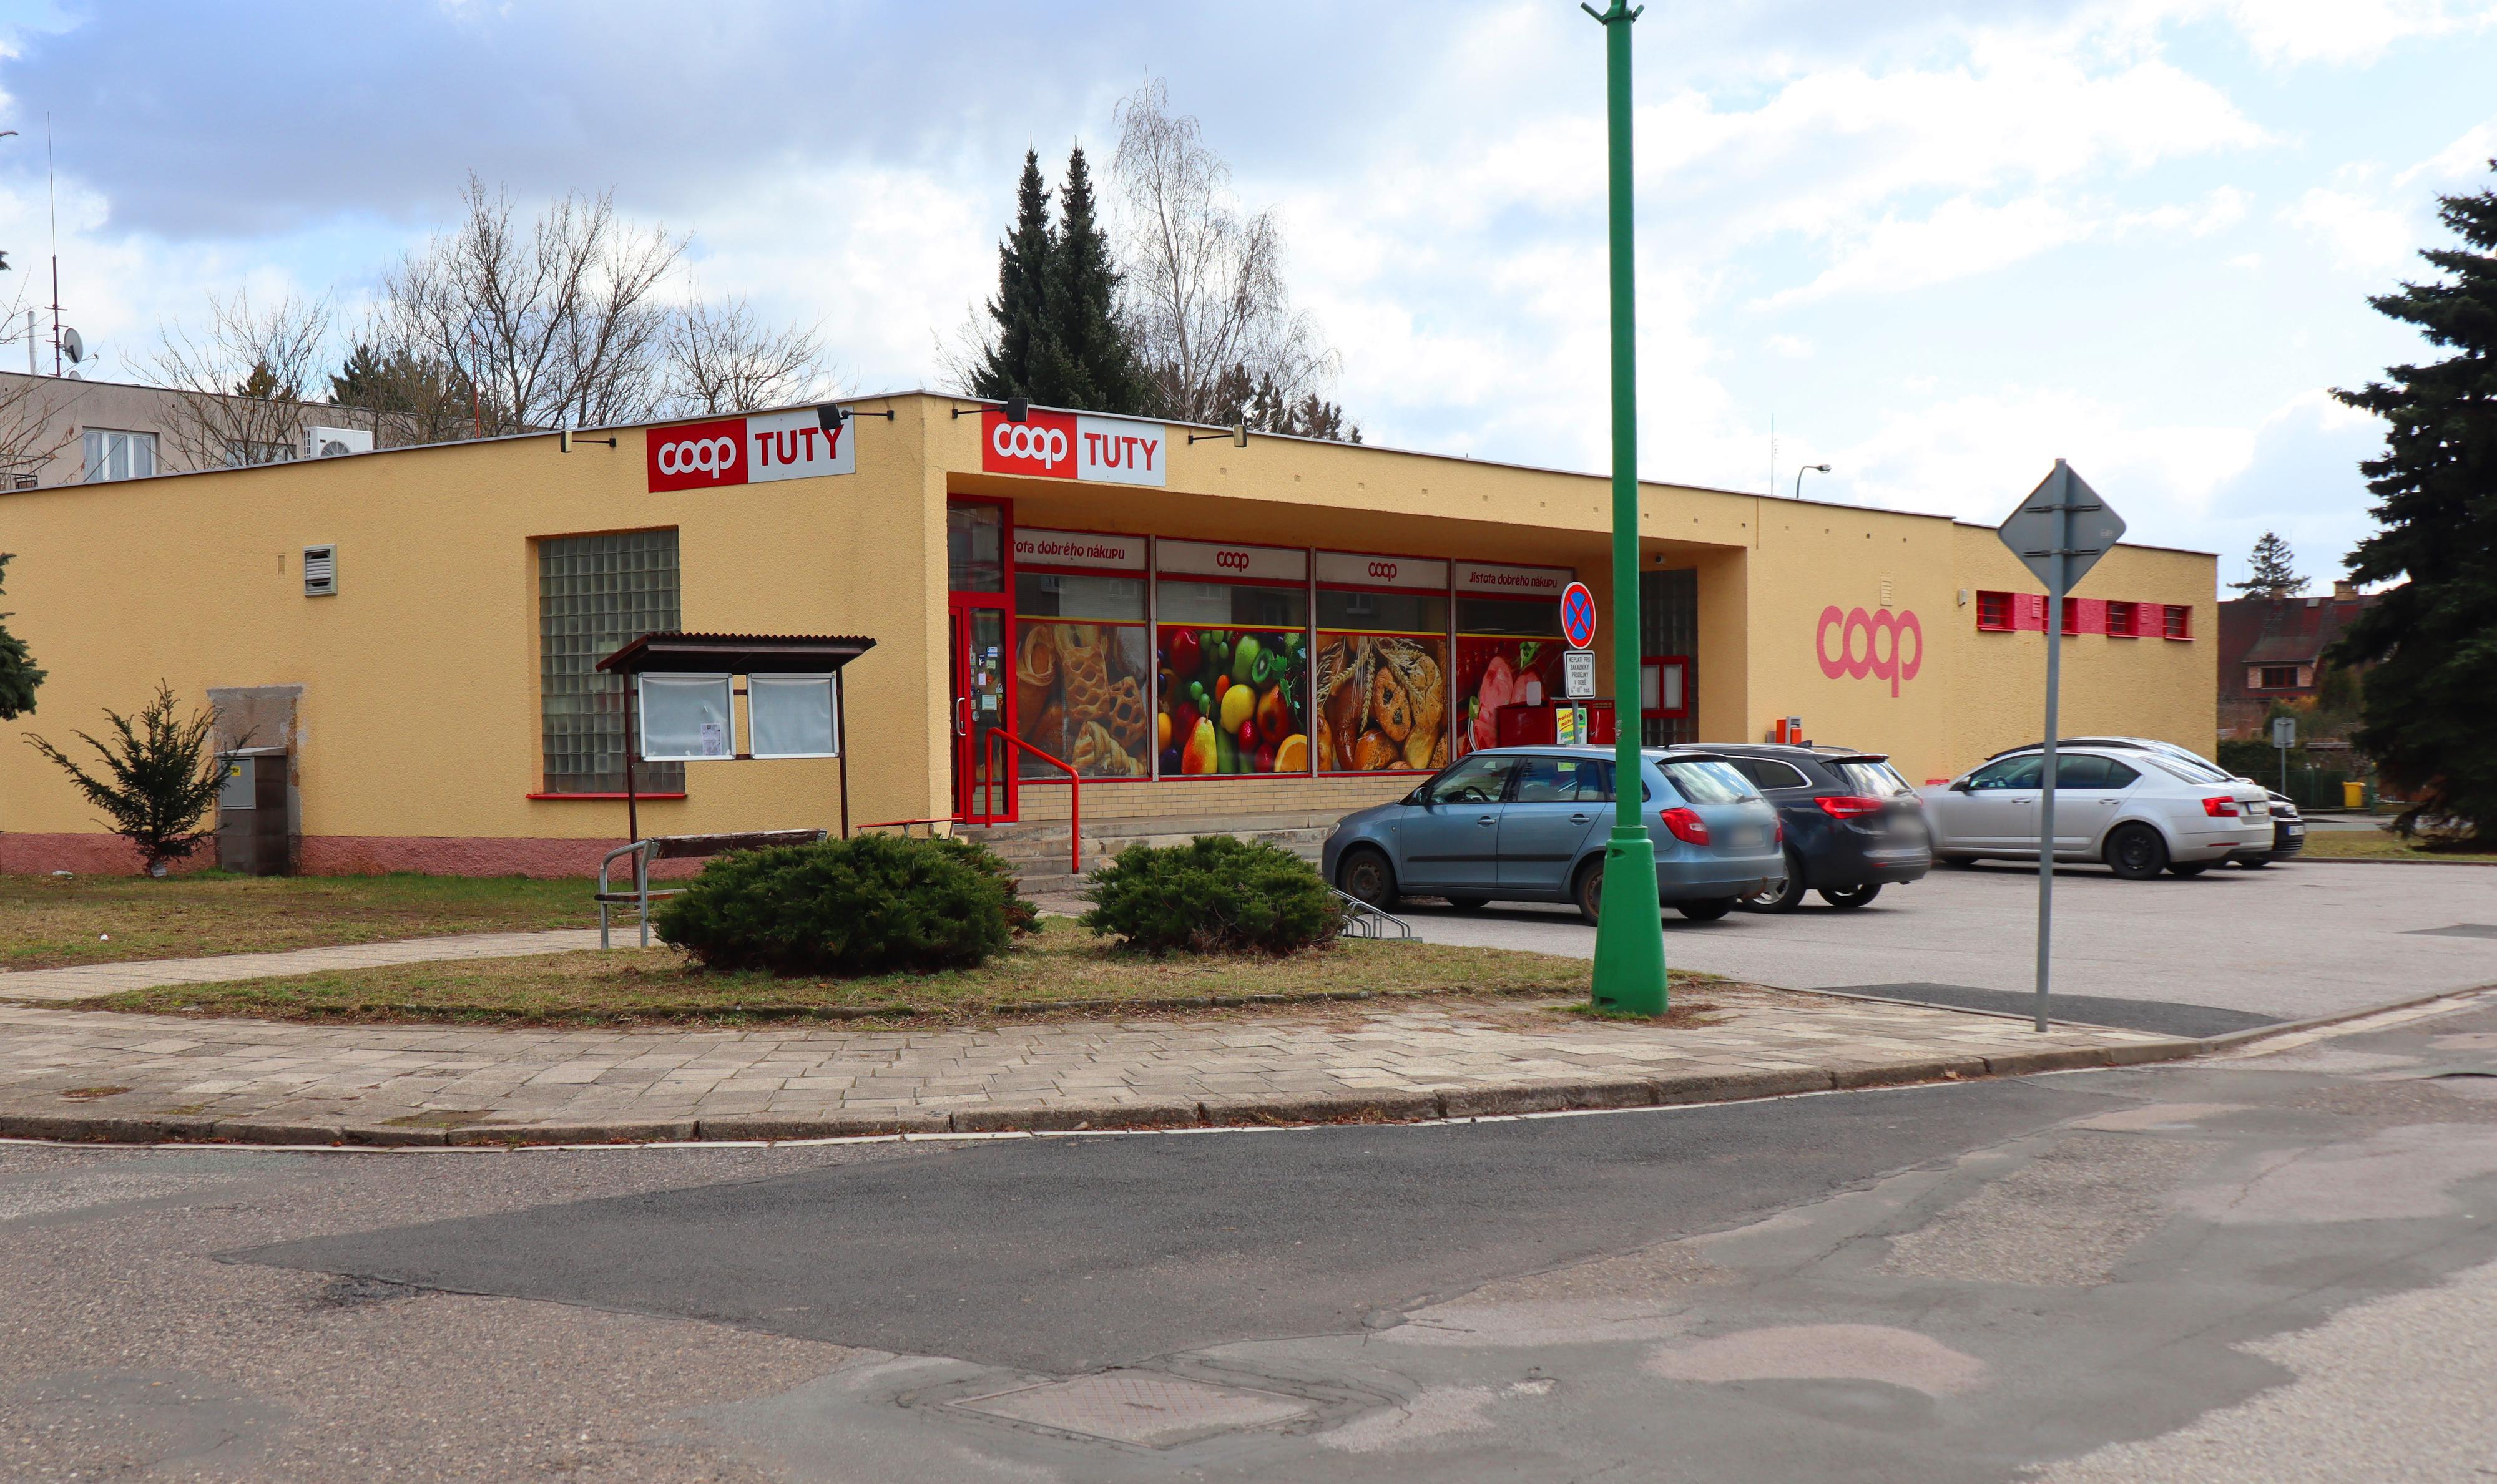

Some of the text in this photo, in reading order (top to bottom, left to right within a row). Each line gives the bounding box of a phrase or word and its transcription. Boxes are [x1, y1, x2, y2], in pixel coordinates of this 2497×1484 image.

[658, 424, 845, 479] coop TUTY
[993, 423, 1158, 471] coop TUTY
[1014, 540, 1125, 560] ota dobrého nákupu
[1217, 551, 1249, 572] coop
[1368, 562, 1397, 582] coop
[1469, 572, 1558, 588] Jistota dobrého nákupu
[1816, 605, 1923, 698] coop
